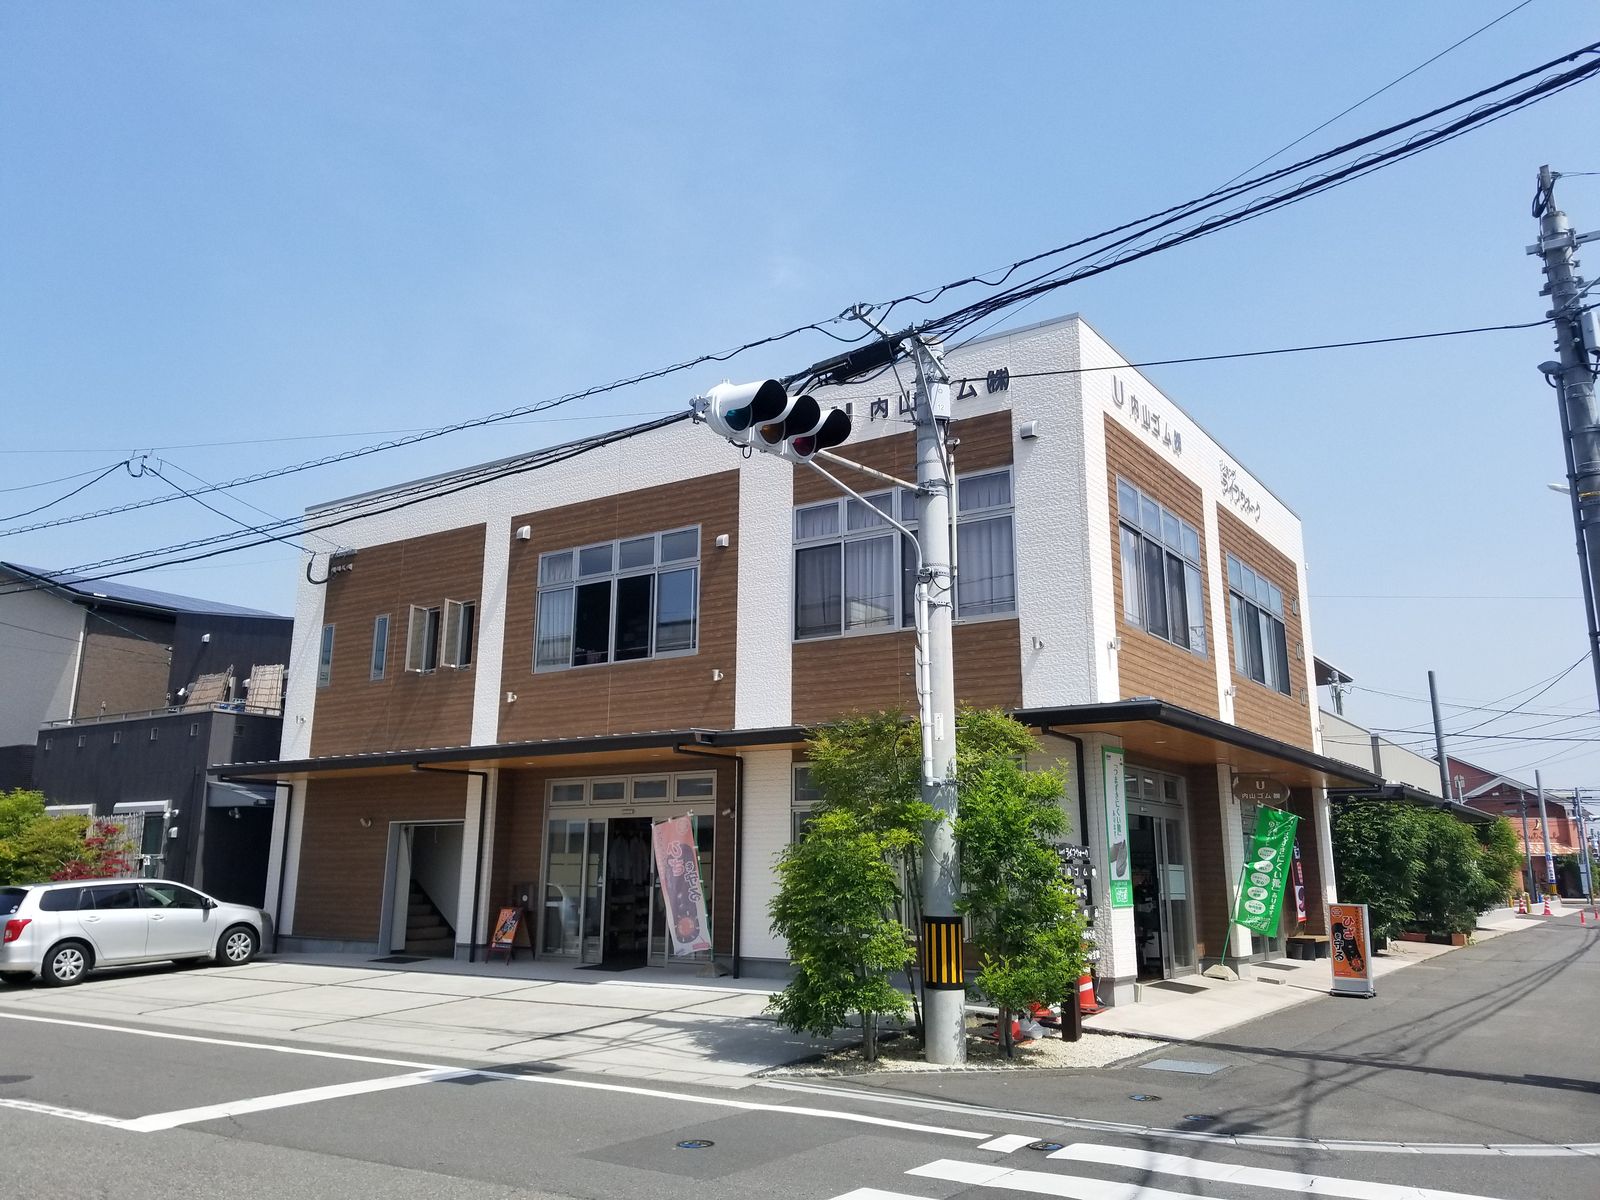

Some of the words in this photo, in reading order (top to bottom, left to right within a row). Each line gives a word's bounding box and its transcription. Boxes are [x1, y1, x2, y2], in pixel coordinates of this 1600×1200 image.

[1112, 375, 1124, 410] U
[1255, 780, 1265, 790] U
[1342, 916, 1355, 940] ひざ
